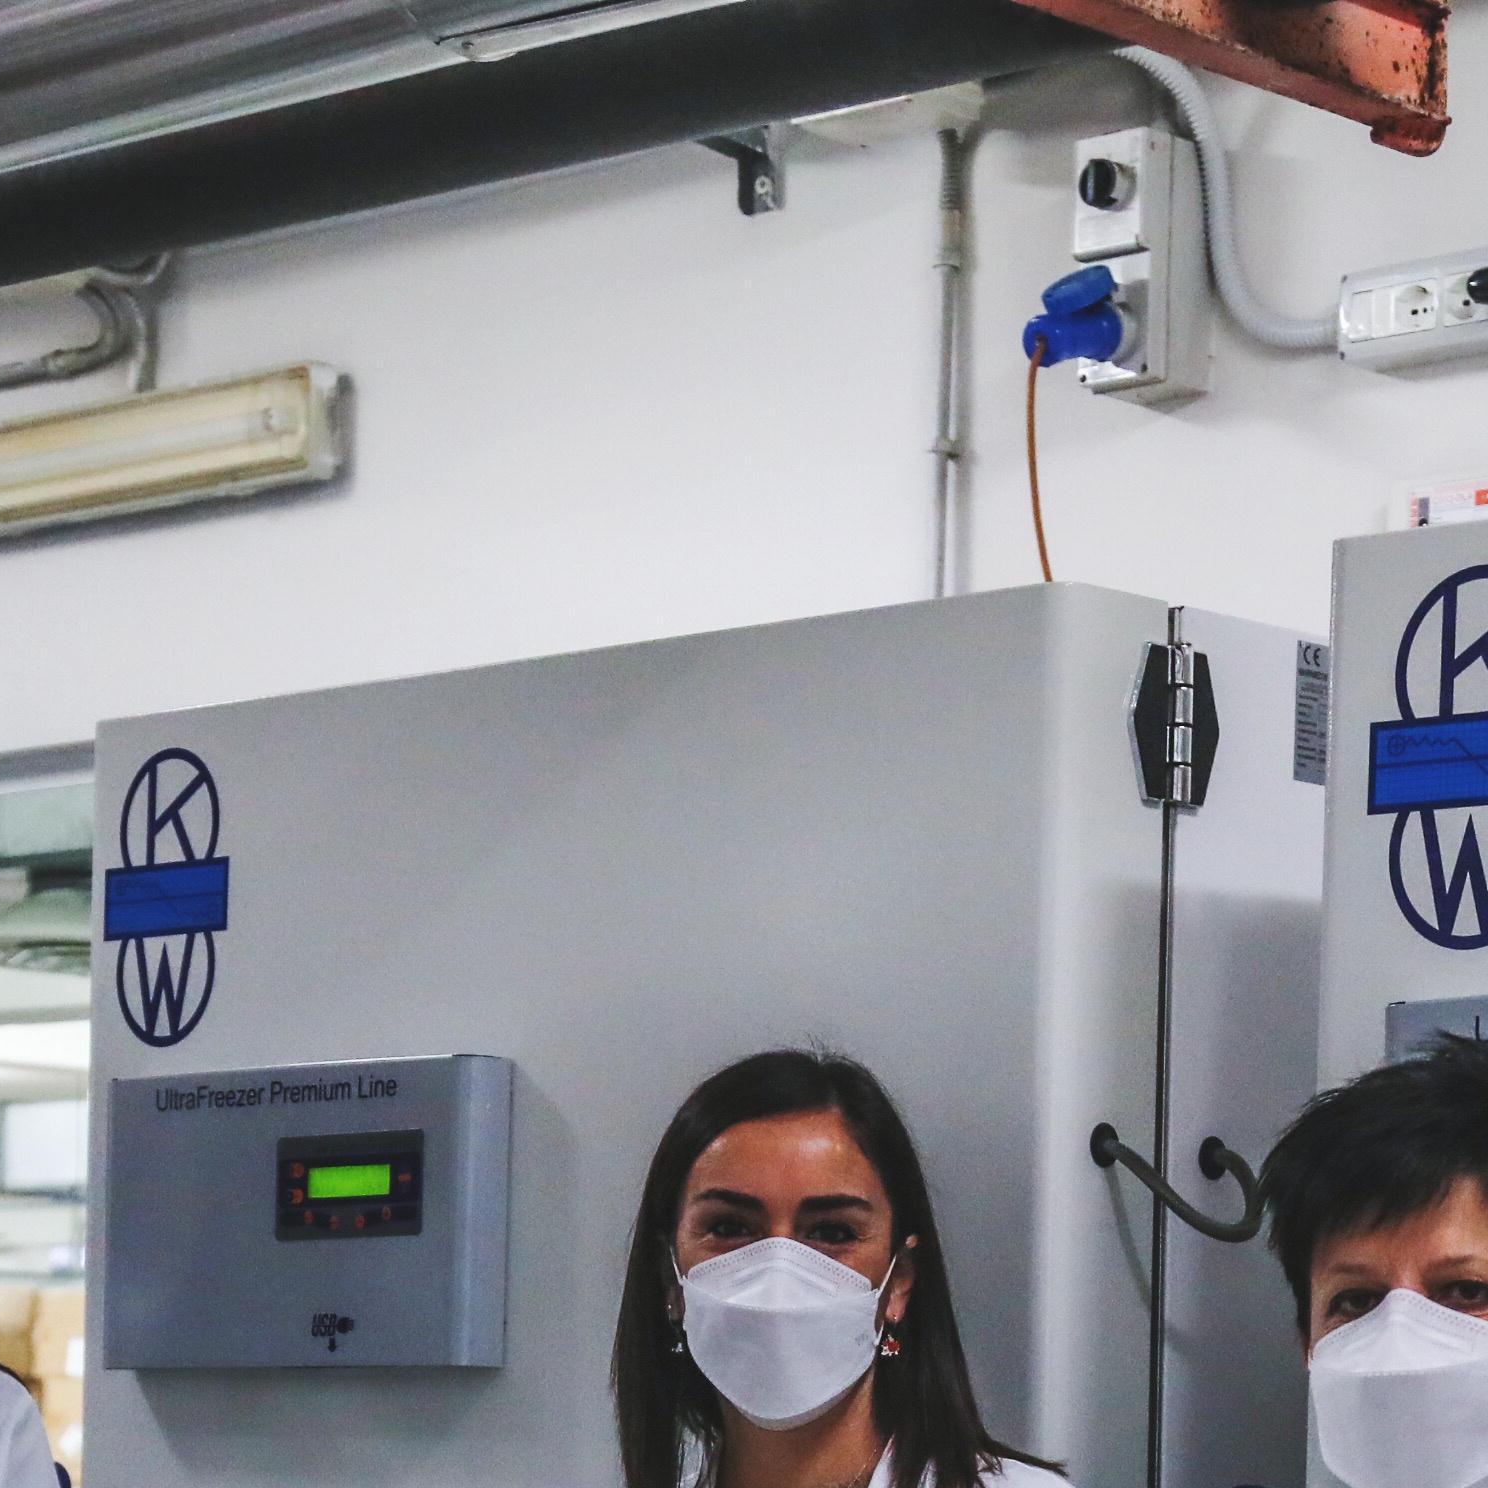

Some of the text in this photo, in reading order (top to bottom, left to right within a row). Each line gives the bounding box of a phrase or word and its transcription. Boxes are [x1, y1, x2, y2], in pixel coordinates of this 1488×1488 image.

[155, 1075, 398, 1112] UltraFreezer Premium Line
